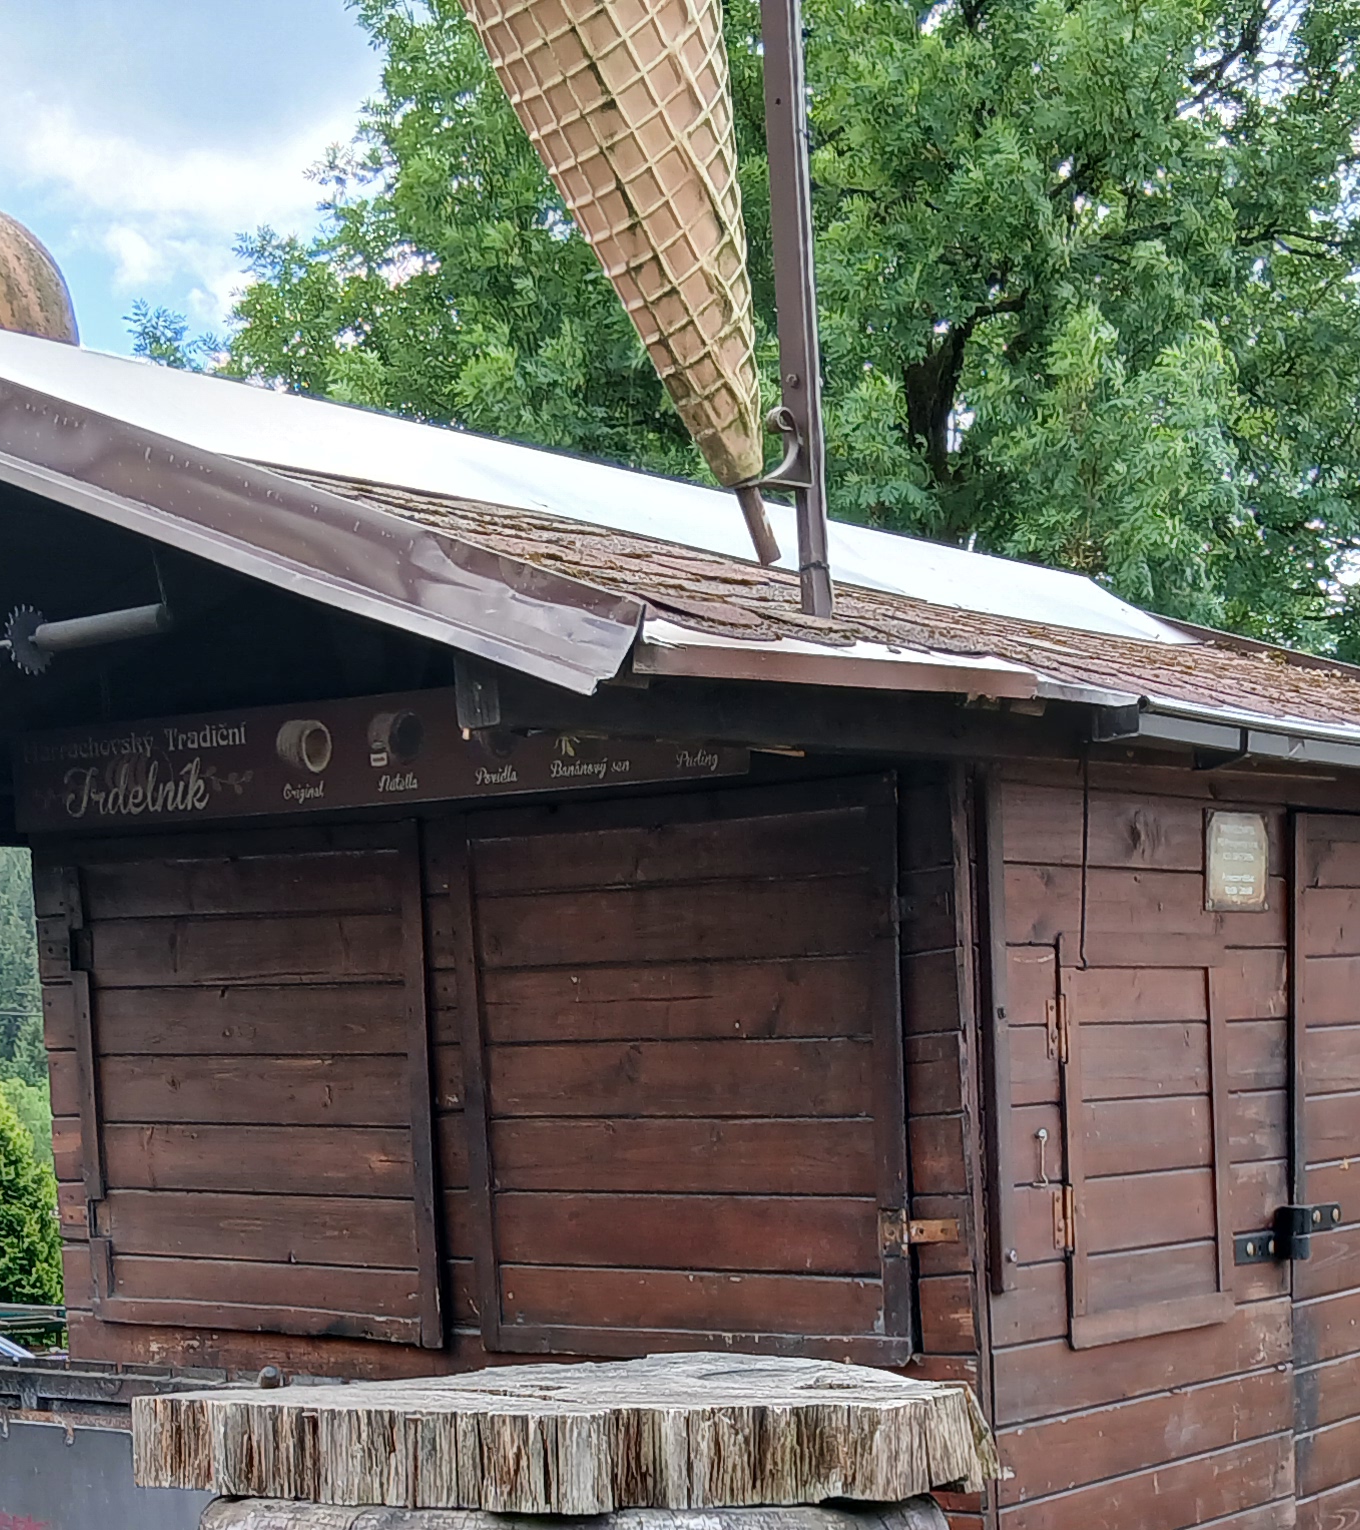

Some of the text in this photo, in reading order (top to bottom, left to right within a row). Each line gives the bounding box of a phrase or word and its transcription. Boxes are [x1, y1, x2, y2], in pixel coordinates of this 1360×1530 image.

[23, 721, 247, 764] Harrachovský Tradiční
[550, 757, 630, 779] Banánový sen
[676, 749, 718, 772] Puding
[475, 764, 517, 785] Povidla
[64, 756, 210, 818] Trdelník
[283, 780, 325, 804] Original
